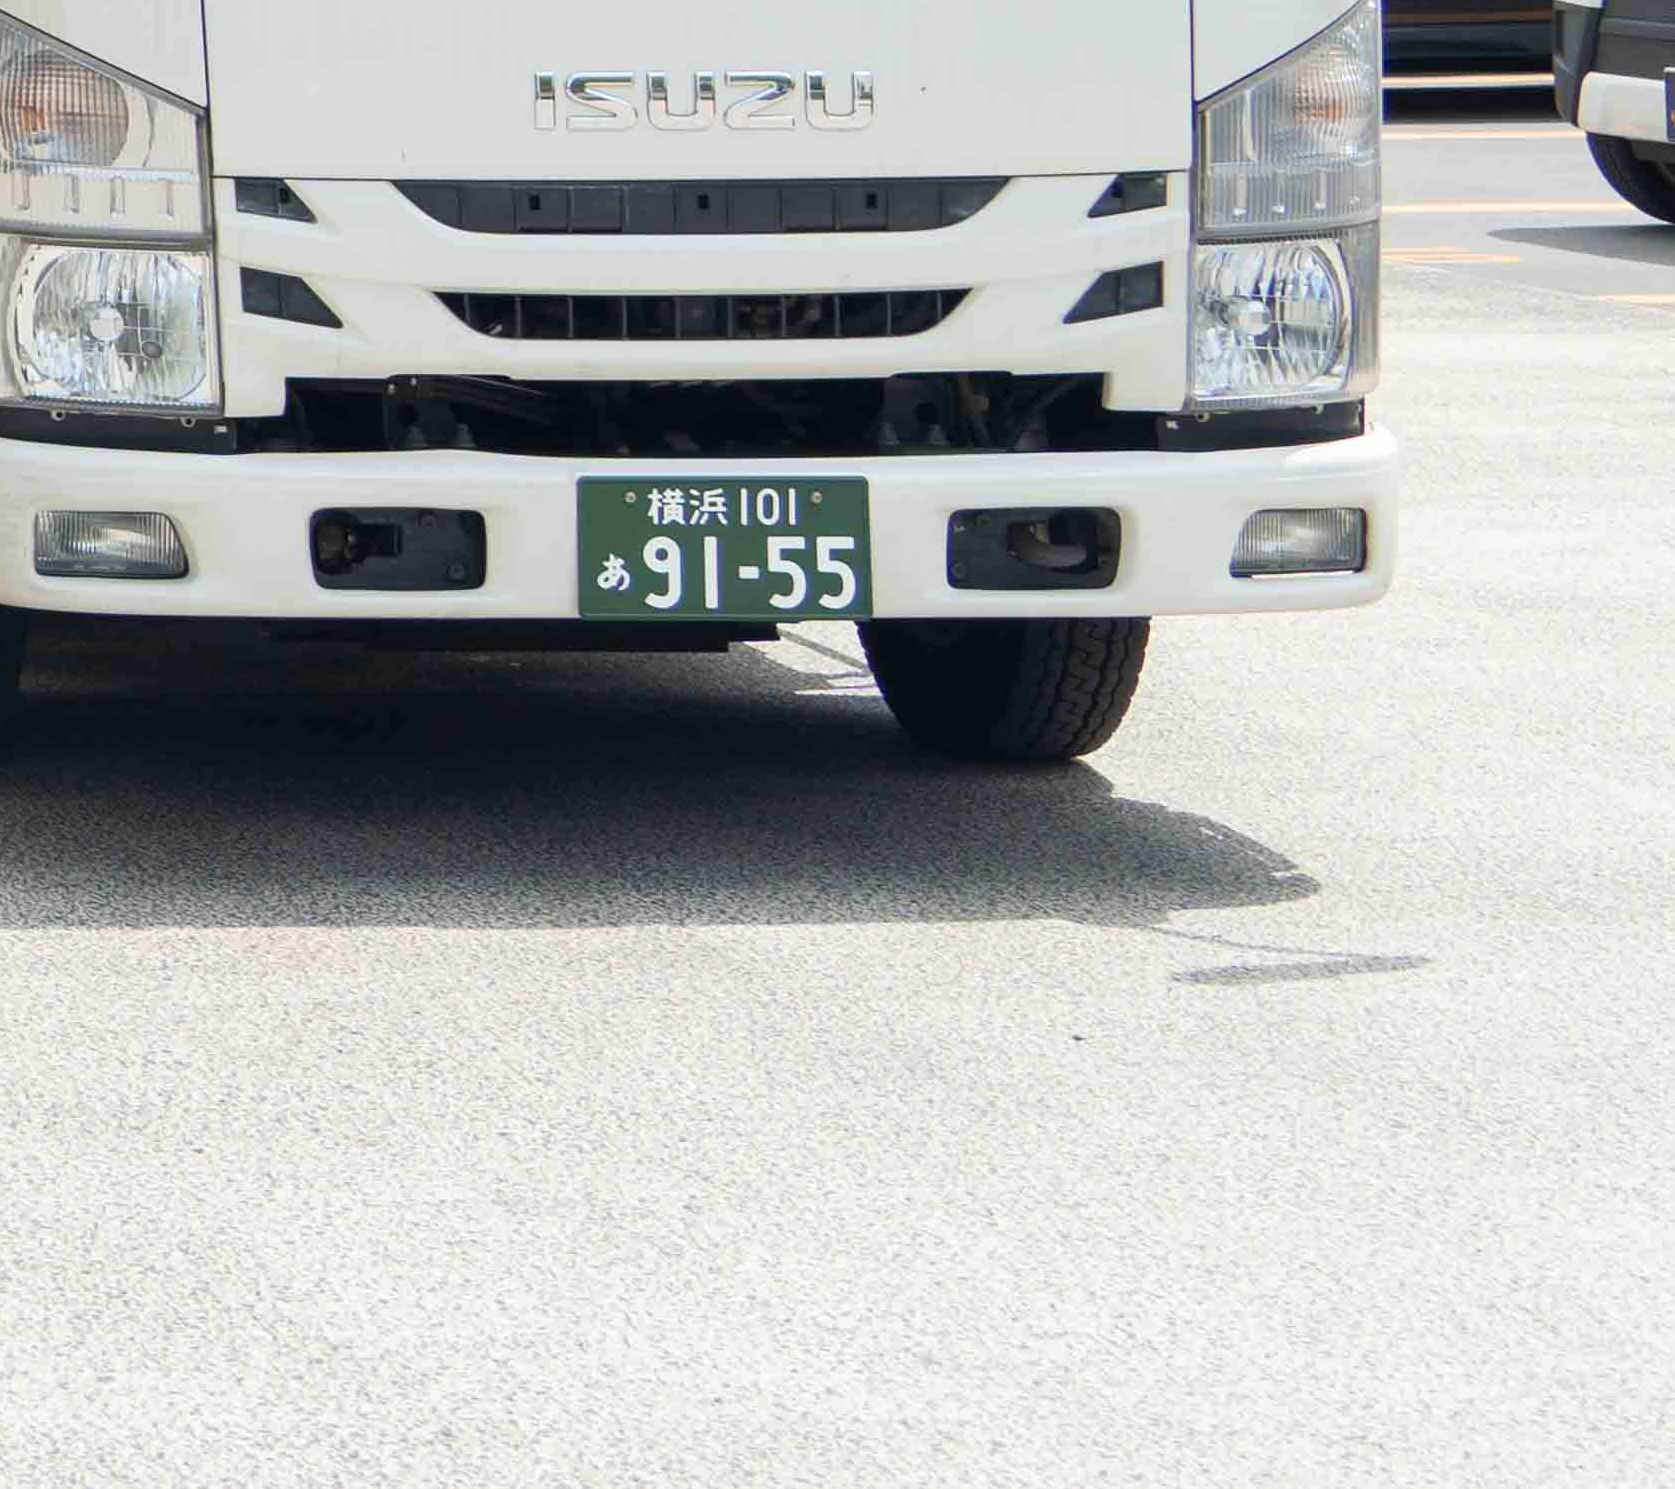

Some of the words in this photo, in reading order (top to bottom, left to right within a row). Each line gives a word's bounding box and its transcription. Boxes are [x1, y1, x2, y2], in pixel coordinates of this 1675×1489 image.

[533, 70, 875, 132] ISUZU
[596, 553, 631, 591] あ
[642, 536, 856, 610] 91-55
